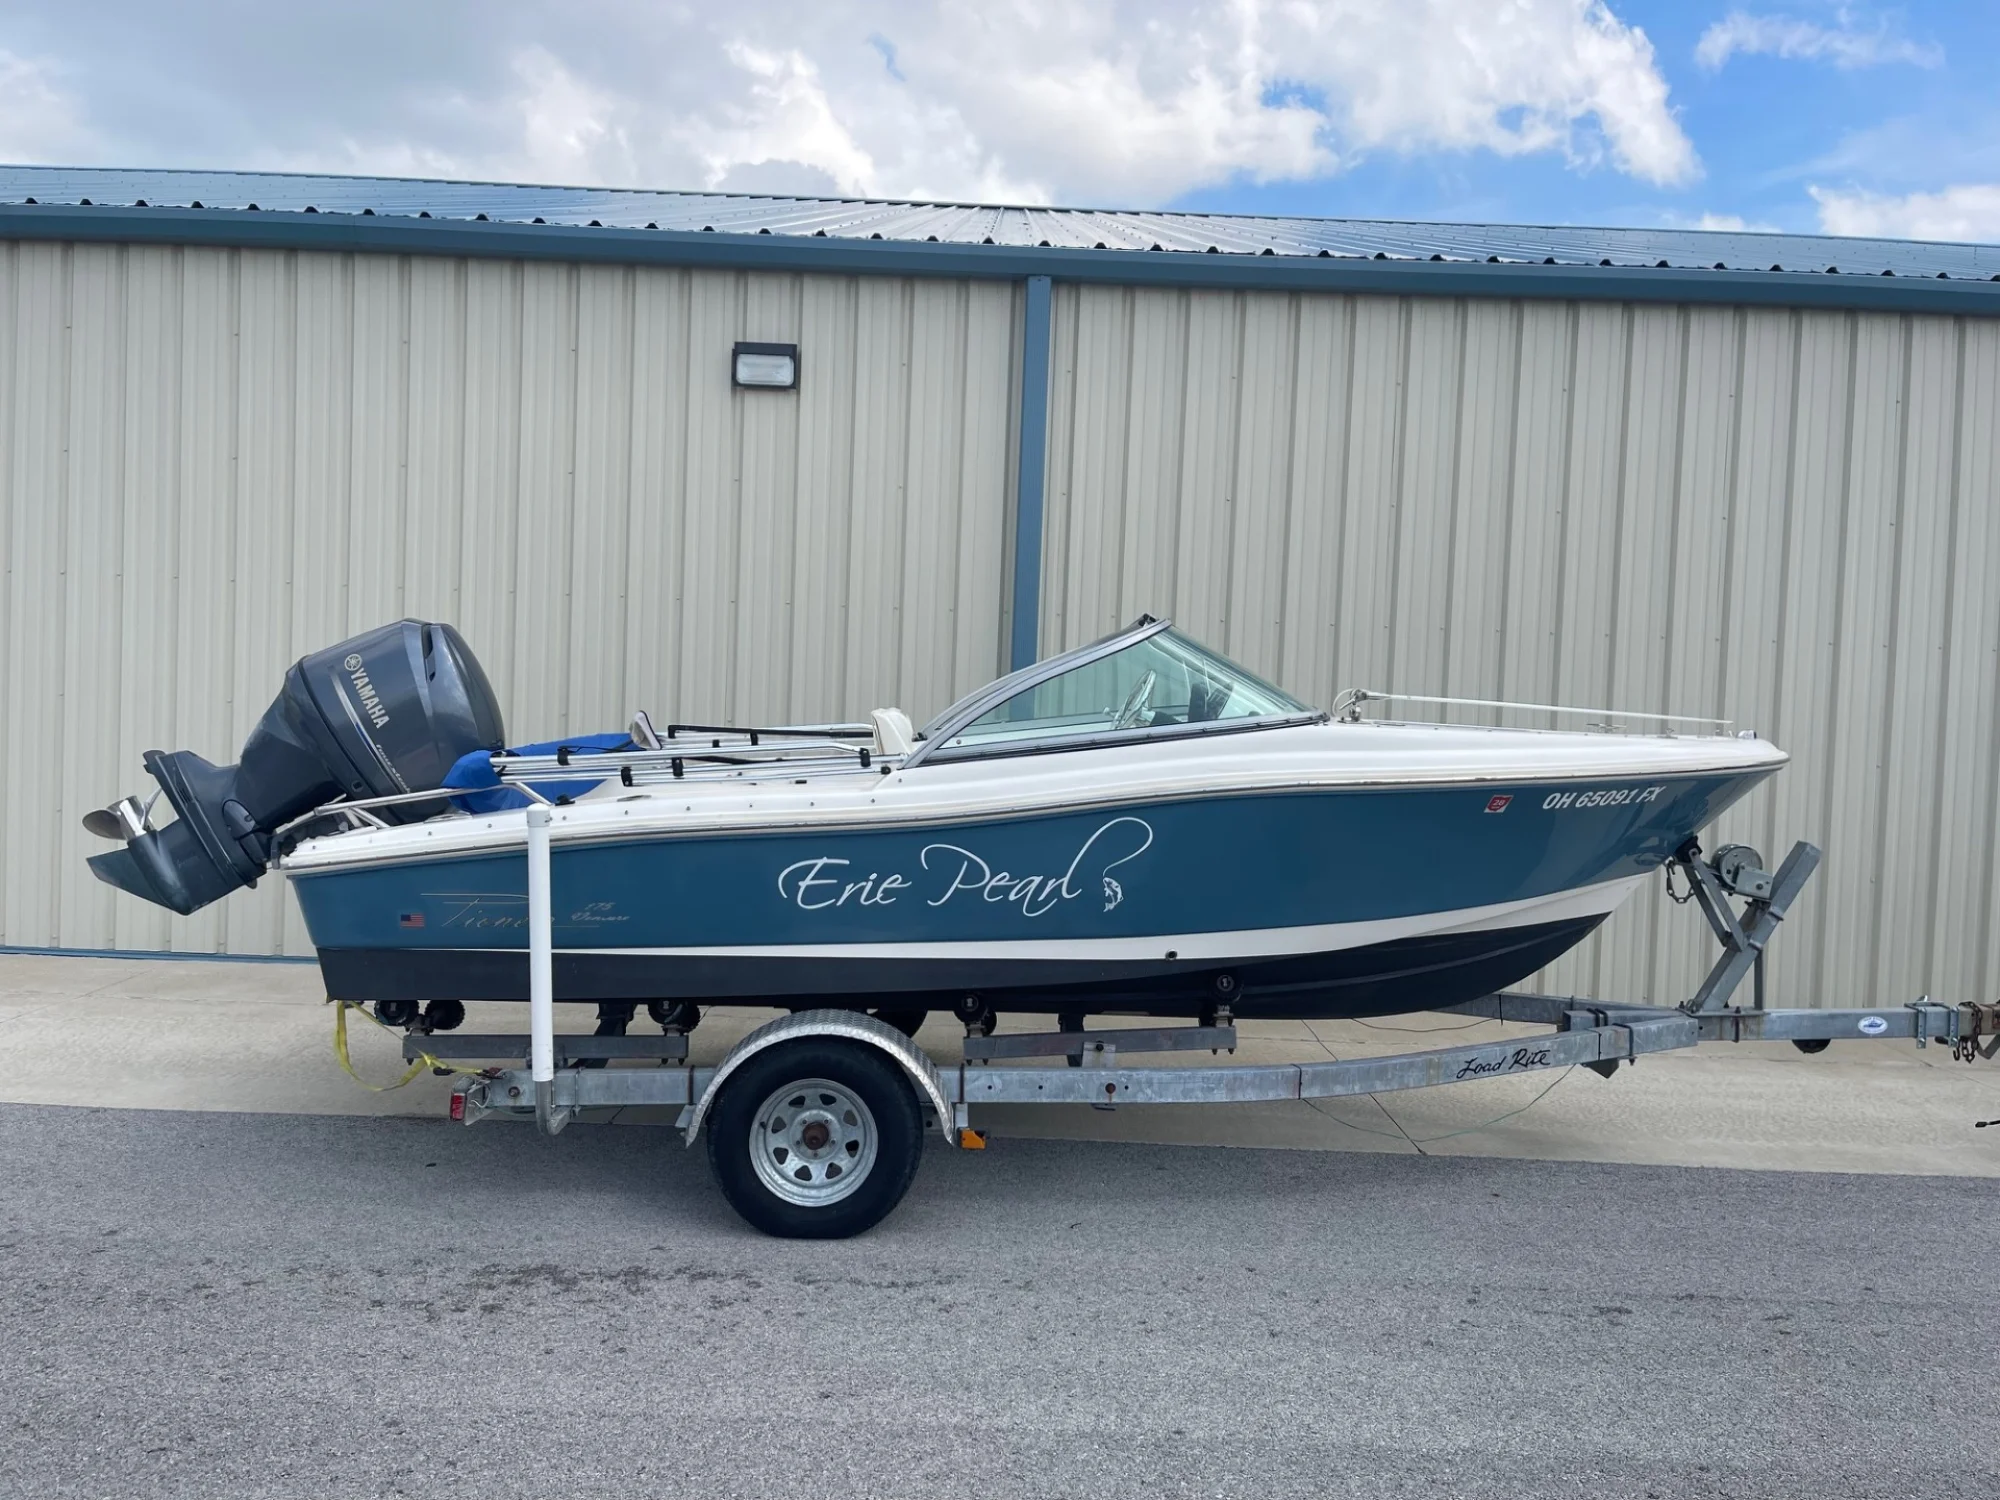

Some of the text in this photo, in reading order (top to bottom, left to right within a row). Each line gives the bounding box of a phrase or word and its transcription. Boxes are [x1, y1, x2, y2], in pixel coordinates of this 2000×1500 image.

[350, 668, 390, 729] YAMAHA
[1542, 786, 1667, 810] OH 65091 FX
[778, 817, 1153, 917] Erie Pearl
[1456, 1048, 1551, 1079] Load Rite
